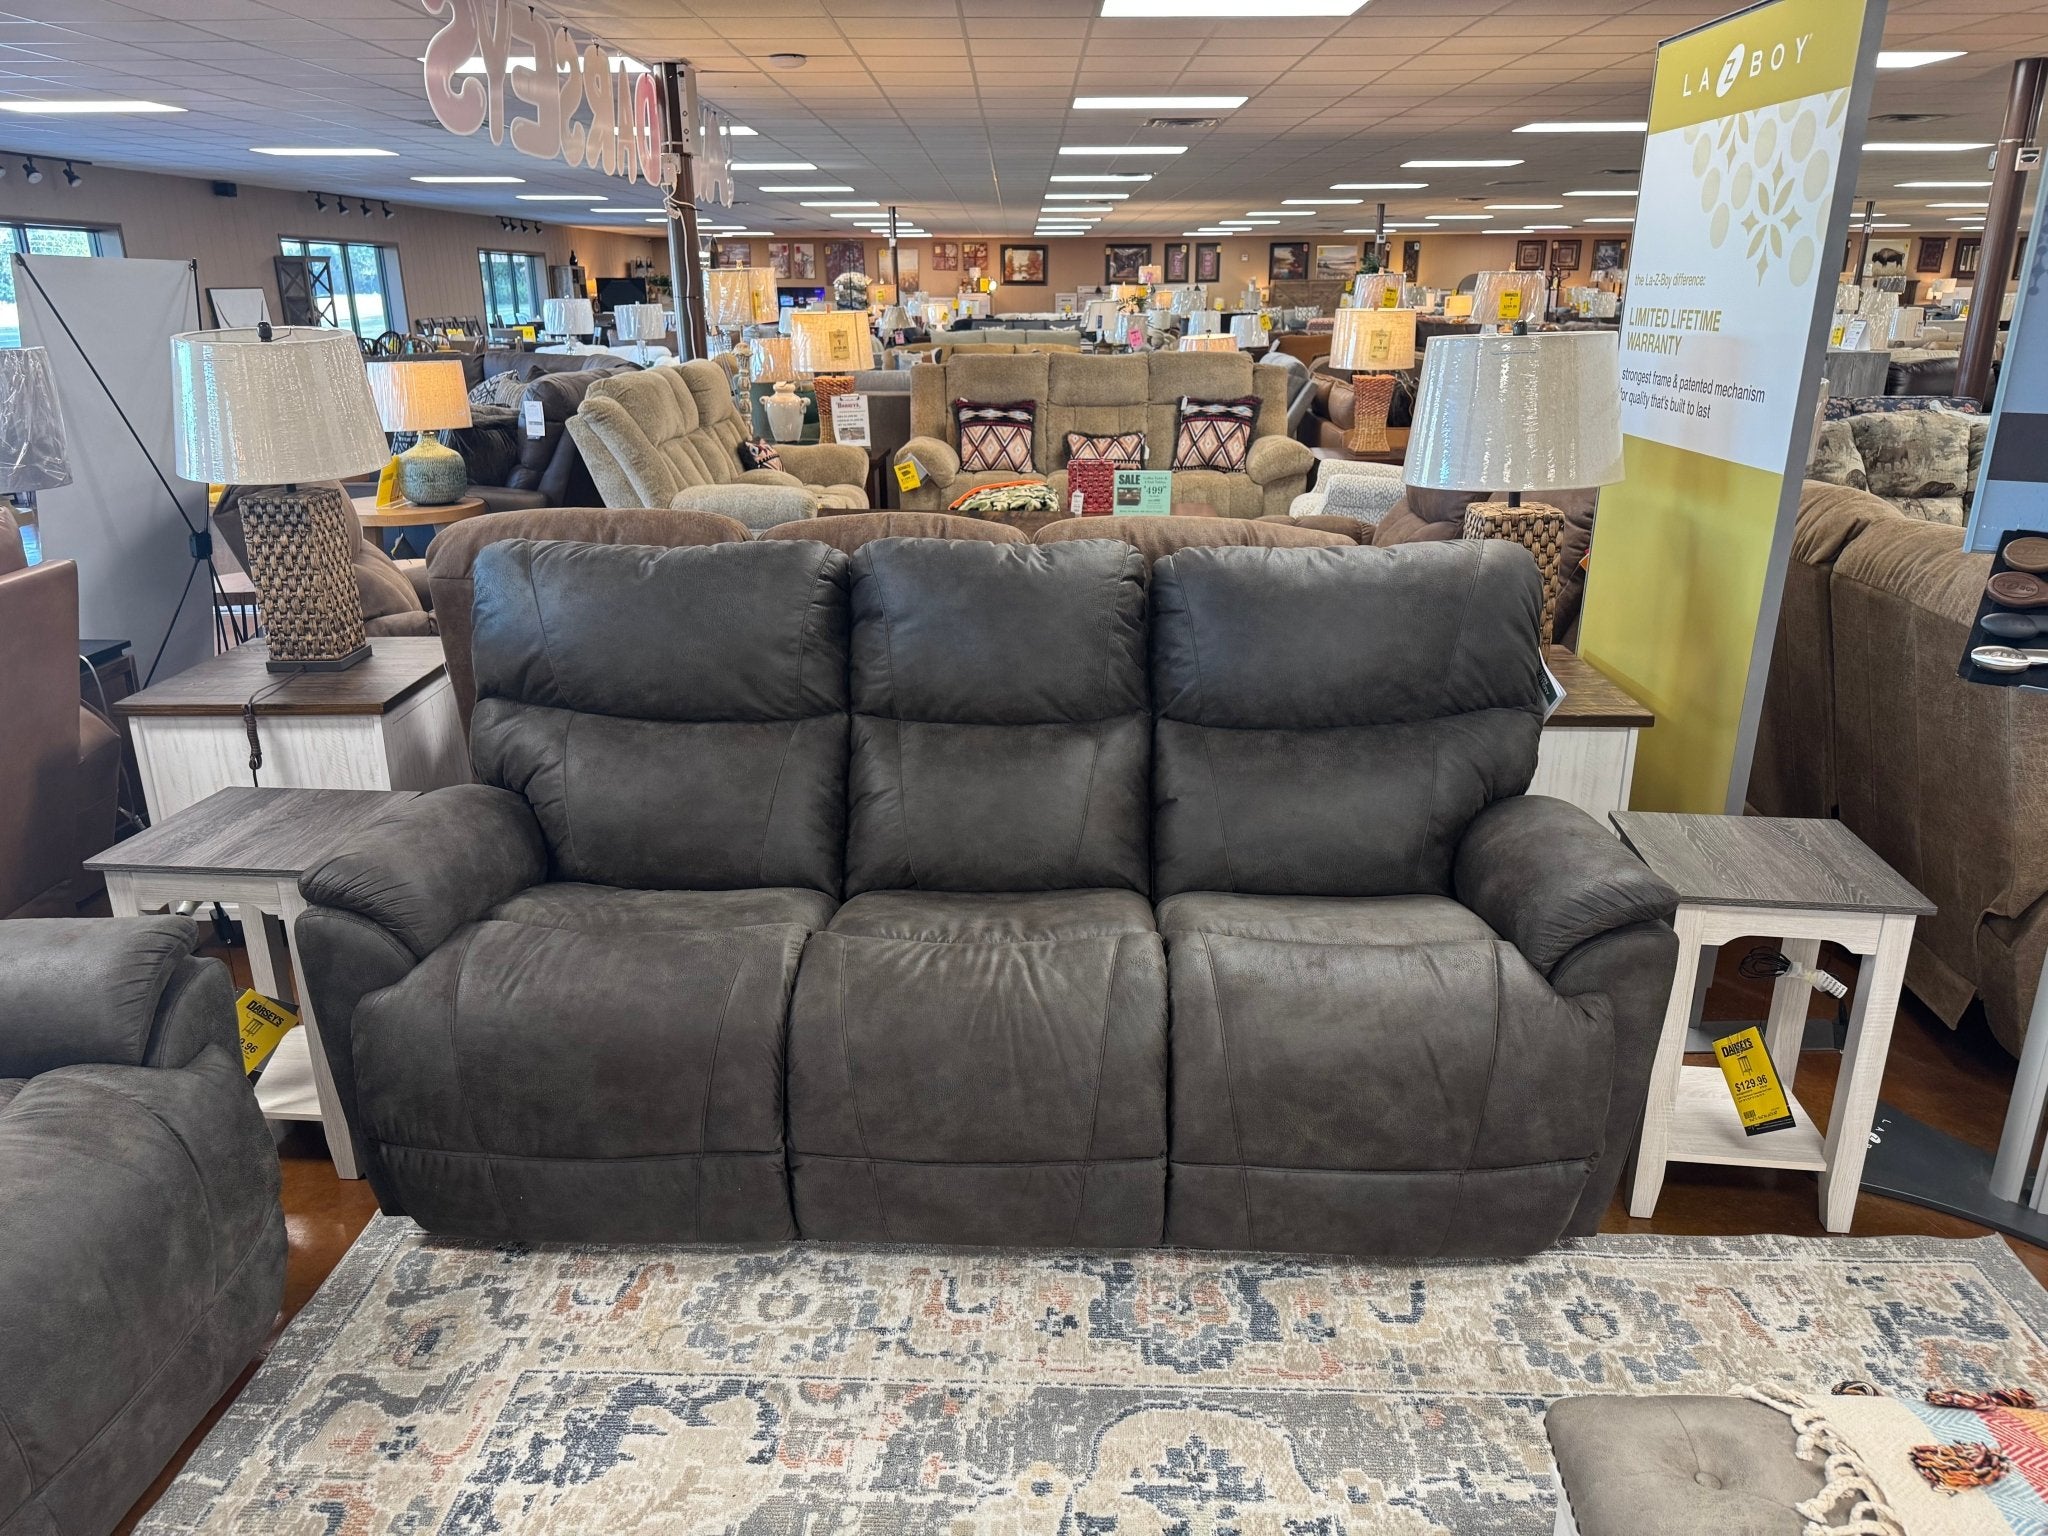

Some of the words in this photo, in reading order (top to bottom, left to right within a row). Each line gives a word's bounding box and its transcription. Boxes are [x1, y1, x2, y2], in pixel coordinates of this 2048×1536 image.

[1634, 274, 1645, 286] the
[1645, 273, 1672, 289] La-Z-Boy
[1672, 273, 1706, 287] difference:
[1629, 307, 1669, 328] LIMITED
[1670, 309, 1722, 332] LIFETIME
[1627, 331, 1682, 356] WARRANTY
[1622, 368, 1652, 386] strongest
[1652, 370, 1672, 388] frame
[1672, 374, 1678, 388] &
[1678, 376, 1714, 395] patented
[1714, 381, 1765, 403] mechanism
[1628, 391, 1650, 409] quality
[1650, 393, 1669, 410] that's
[1669, 397, 1686, 414] built
[1686, 401, 1694, 415] to
[1695, 401, 1711, 419] last
[1118, 474, 1141, 485] SALE
[246, 1000, 285, 1028] DARSEY'S
[1734, 1074, 1768, 1093] $129.96
